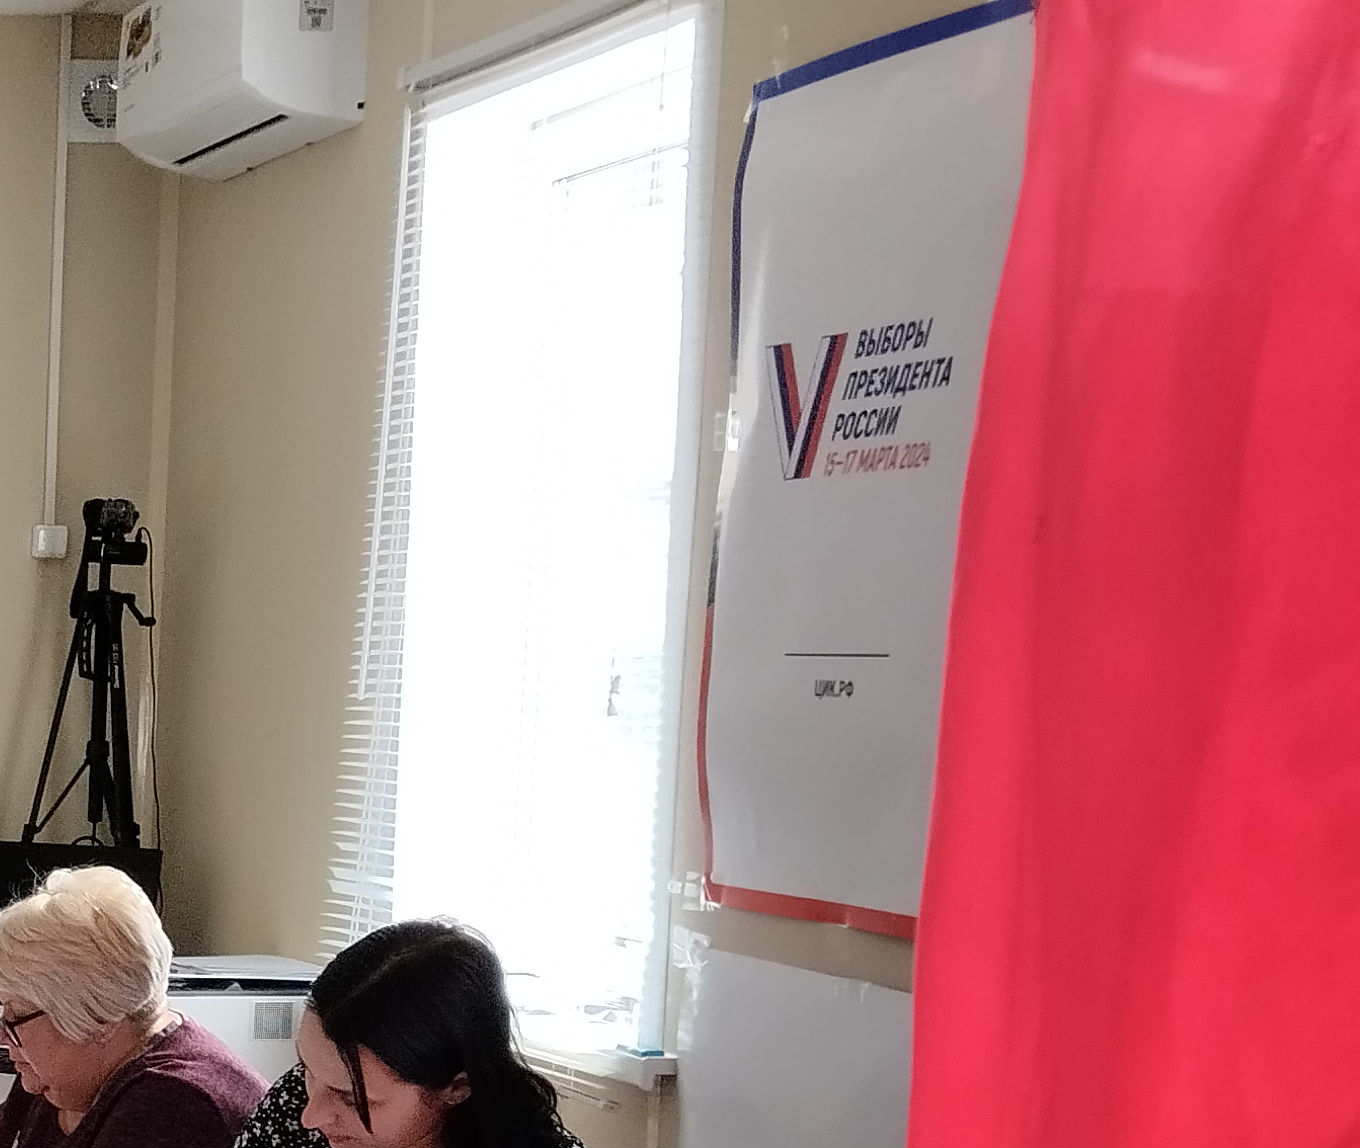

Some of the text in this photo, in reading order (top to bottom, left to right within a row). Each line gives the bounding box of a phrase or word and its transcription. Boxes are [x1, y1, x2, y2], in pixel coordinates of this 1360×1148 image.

[854, 317, 934, 359] ВЫБОРЫ
[842, 356, 954, 400] ПРЕЗИДЕНТА
[831, 405, 902, 442] РОССИИ
[856, 445, 898, 474] МАРТА
[899, 442, 932, 470] 2024
